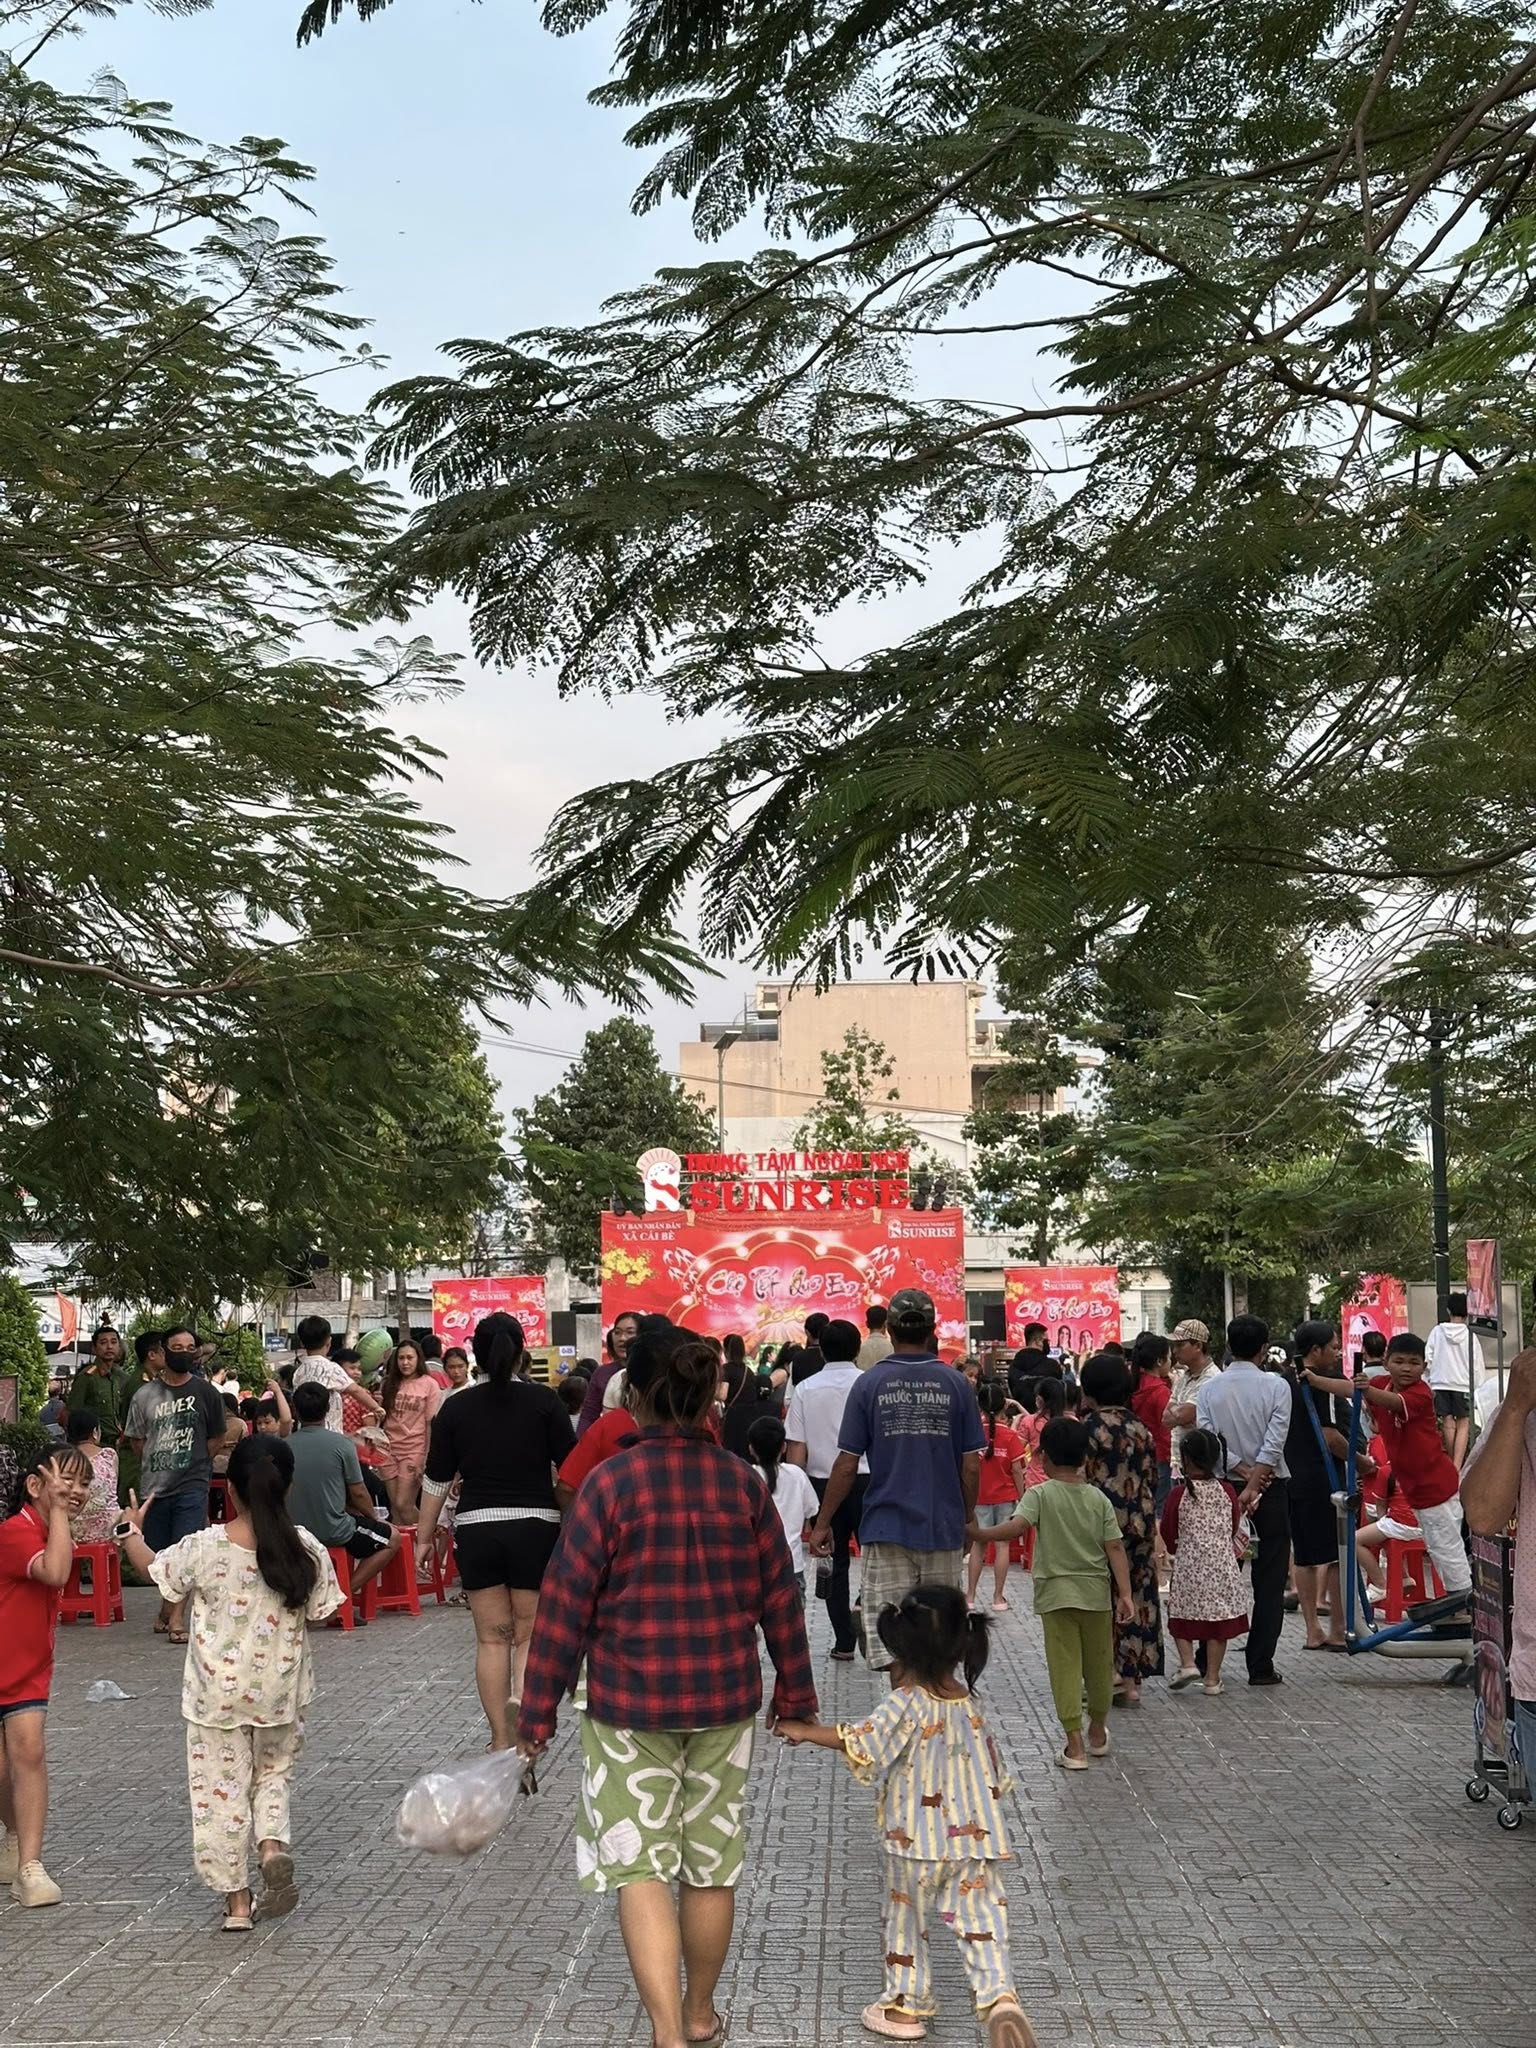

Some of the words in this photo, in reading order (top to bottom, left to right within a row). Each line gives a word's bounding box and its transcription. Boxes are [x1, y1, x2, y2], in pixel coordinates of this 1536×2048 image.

[684, 1152, 747, 1172] TRUNG
[756, 1148, 795, 1171] TÂM
[689, 1179, 910, 1212] SUNRISE
[623, 1230, 638, 1241] XÃ
[640, 1230, 659, 1241] CÁI
[661, 1229, 675, 1241] BÈ
[902, 1227, 956, 1239] SUNRISE
[154, 1395, 196, 1418] NEVER
[878, 1389, 912, 1406] PHƯỚC
[914, 1390, 951, 1405] THÀNH
